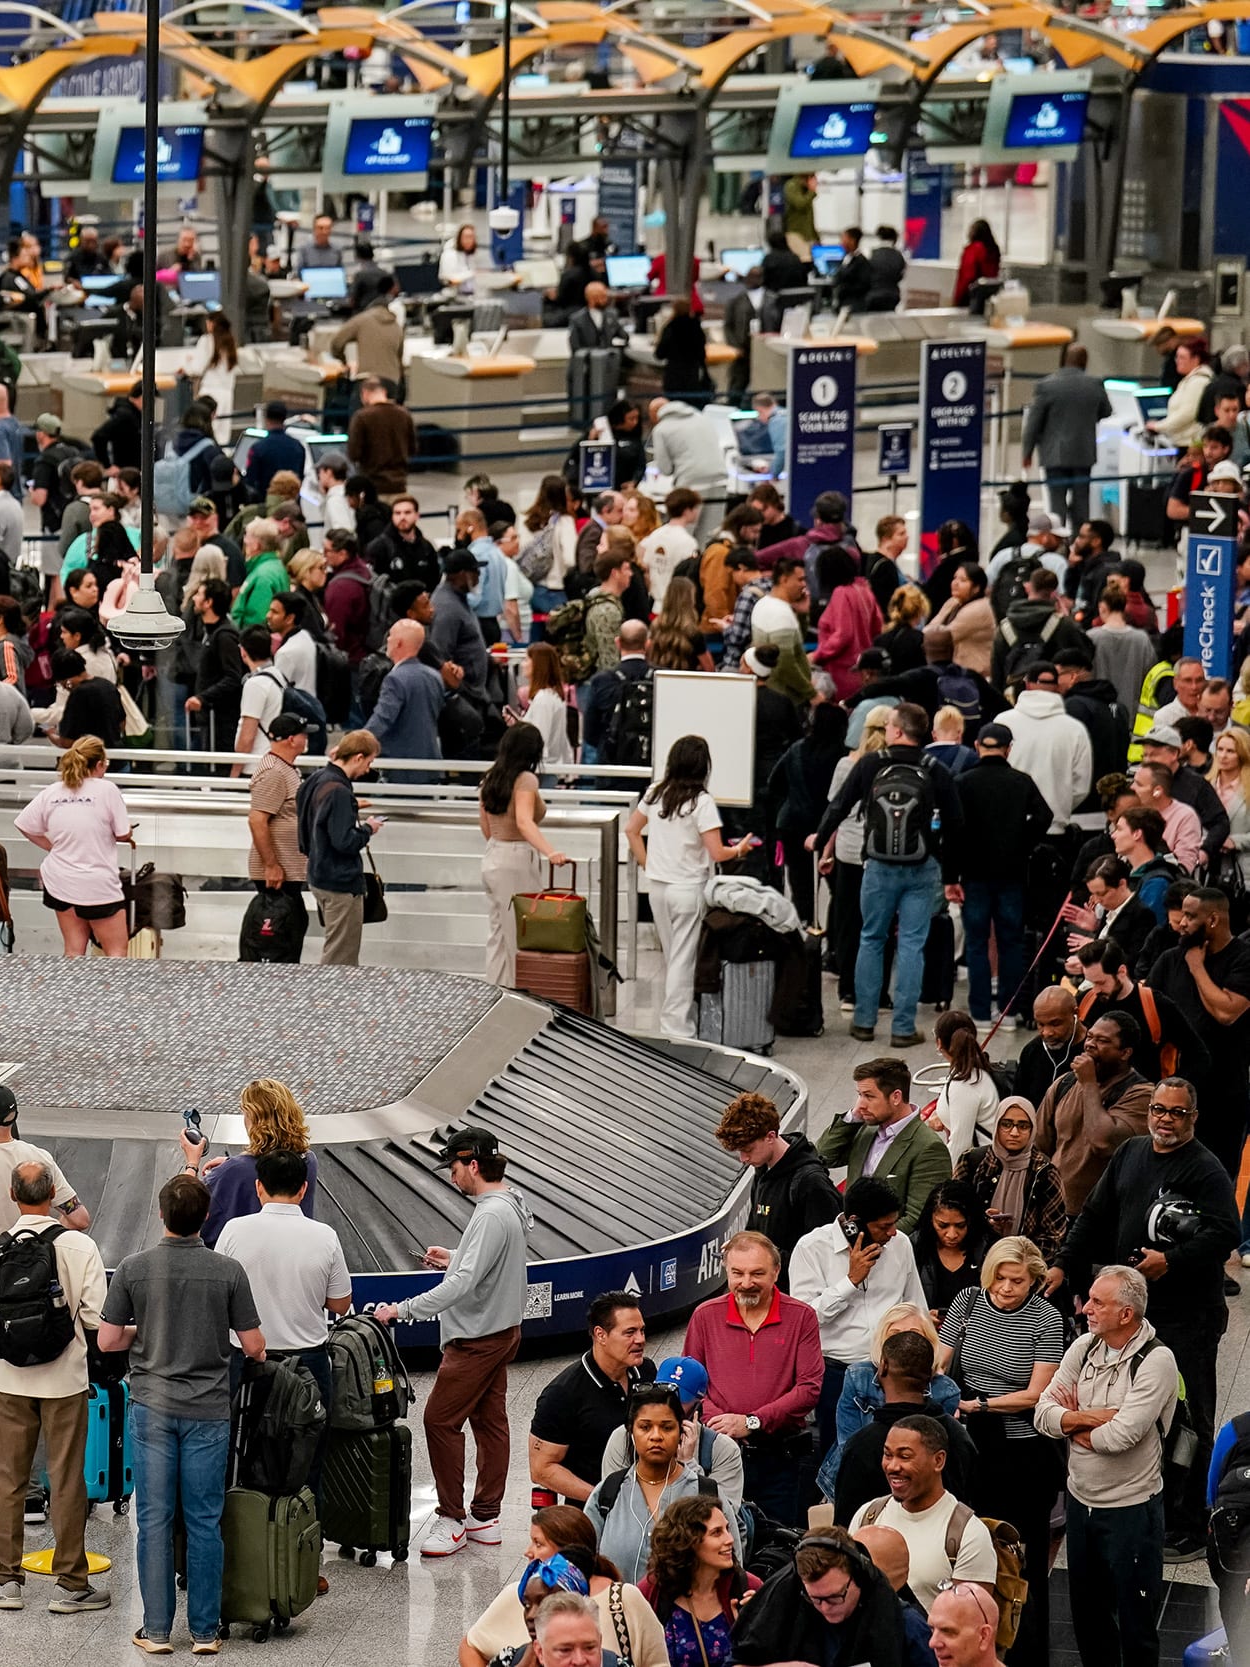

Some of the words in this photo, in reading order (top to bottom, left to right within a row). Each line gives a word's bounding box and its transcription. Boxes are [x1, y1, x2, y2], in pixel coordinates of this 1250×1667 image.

[808, 351, 843, 363] DELTA
[940, 348, 973, 359] DELTA
[949, 377, 958, 395] 2
[554, 1293, 570, 1301] LEARN
[570, 1291, 584, 1300] MORE
